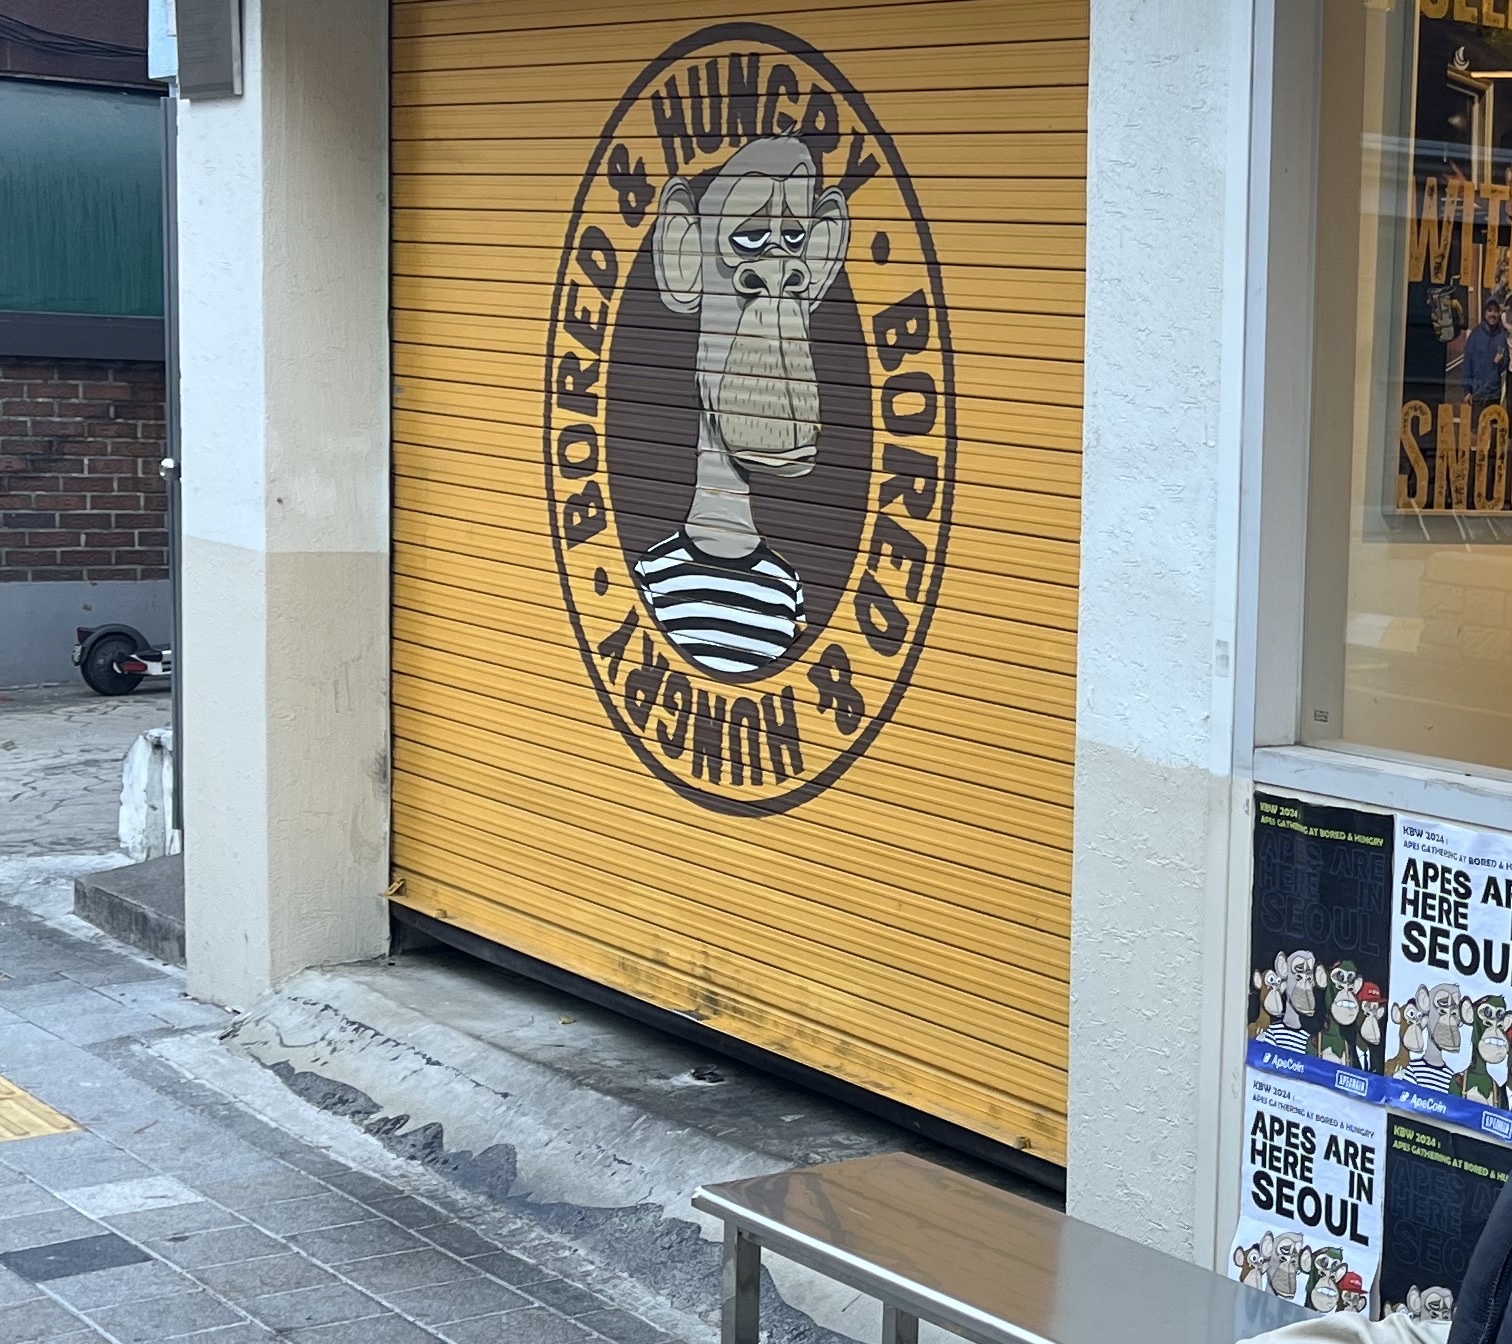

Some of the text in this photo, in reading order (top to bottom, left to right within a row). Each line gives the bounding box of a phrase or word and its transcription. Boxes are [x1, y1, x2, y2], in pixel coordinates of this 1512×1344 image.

[554, 52, 881, 551] BORED & HUNGRY
[598, 289, 938, 787] BORED & HUNGRY
[1400, 858, 1474, 899] APES
[1400, 886, 1471, 930] HERE
[1250, 1110, 1375, 1175] APES ARE
[1250, 1137, 1373, 1205] HERE IN
[1251, 1170, 1368, 1246] SEOUL
